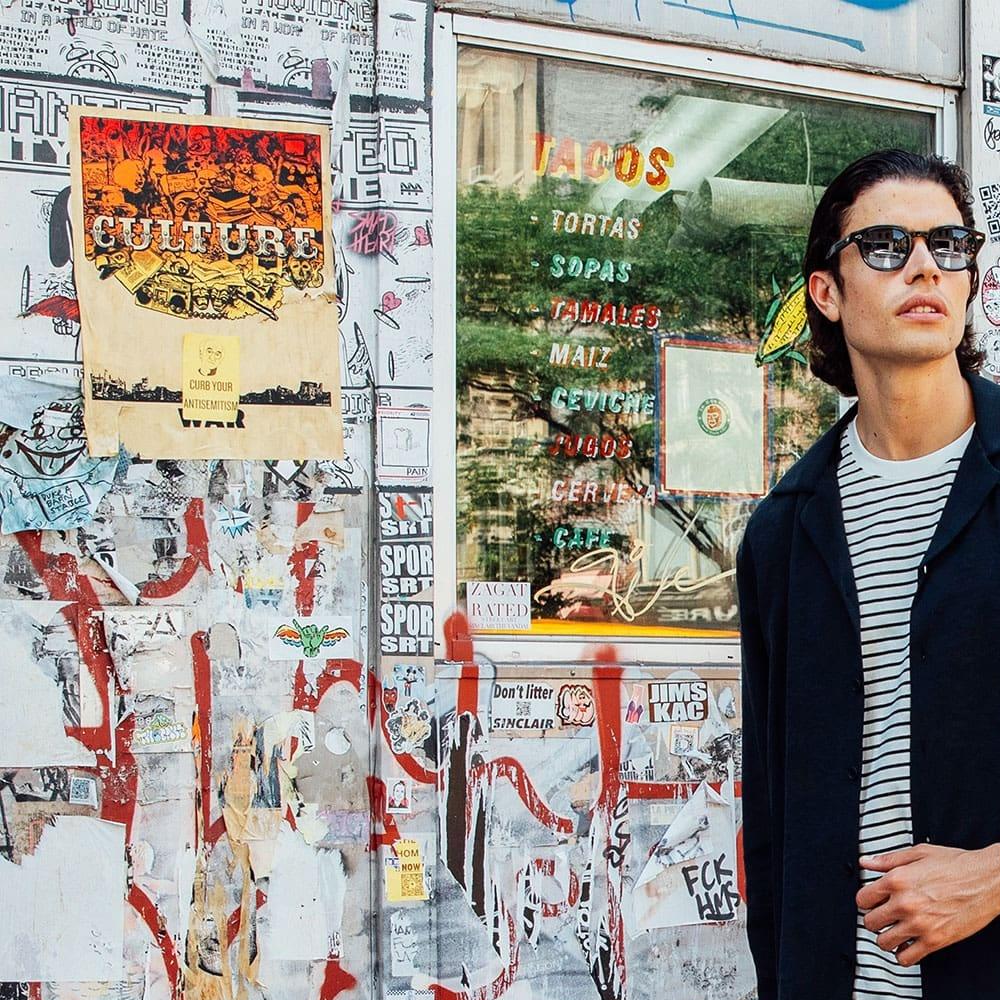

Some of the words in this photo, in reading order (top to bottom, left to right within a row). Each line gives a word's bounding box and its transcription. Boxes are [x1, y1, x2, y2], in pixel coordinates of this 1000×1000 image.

[56, 16, 102, 31] WRLD
[530, 132, 674, 191] TACOS
[551, 209, 643, 240] TORTAS
[93, 215, 319, 260] CULTURE
[551, 254, 632, 284] SOPAS
[551, 297, 662, 330] TAMALES
[549, 341, 612, 372] MAIZ
[189, 379, 210, 391] CURB
[212, 381, 233, 393] YOUR
[183, 399, 239, 412] ANTISEMITISM
[551, 386, 656, 415] CEVICHE
[551, 432, 632, 460] JUGOS
[380, 544, 433, 576] SPOR
[382, 577, 433, 594] SRT
[472, 583, 528, 597] ZAGAT
[381, 604, 433, 636] SPOR
[472, 603, 528, 616] RATED
[381, 637, 433, 653] SRT
[494, 683, 523, 699] Don't
[526, 683, 554, 700] litter
[649, 682, 707, 703] JIMS
[493, 717, 554, 729] SINCLAIR
[651, 701, 704, 722] KAC
[682, 853, 733, 897] FCK
